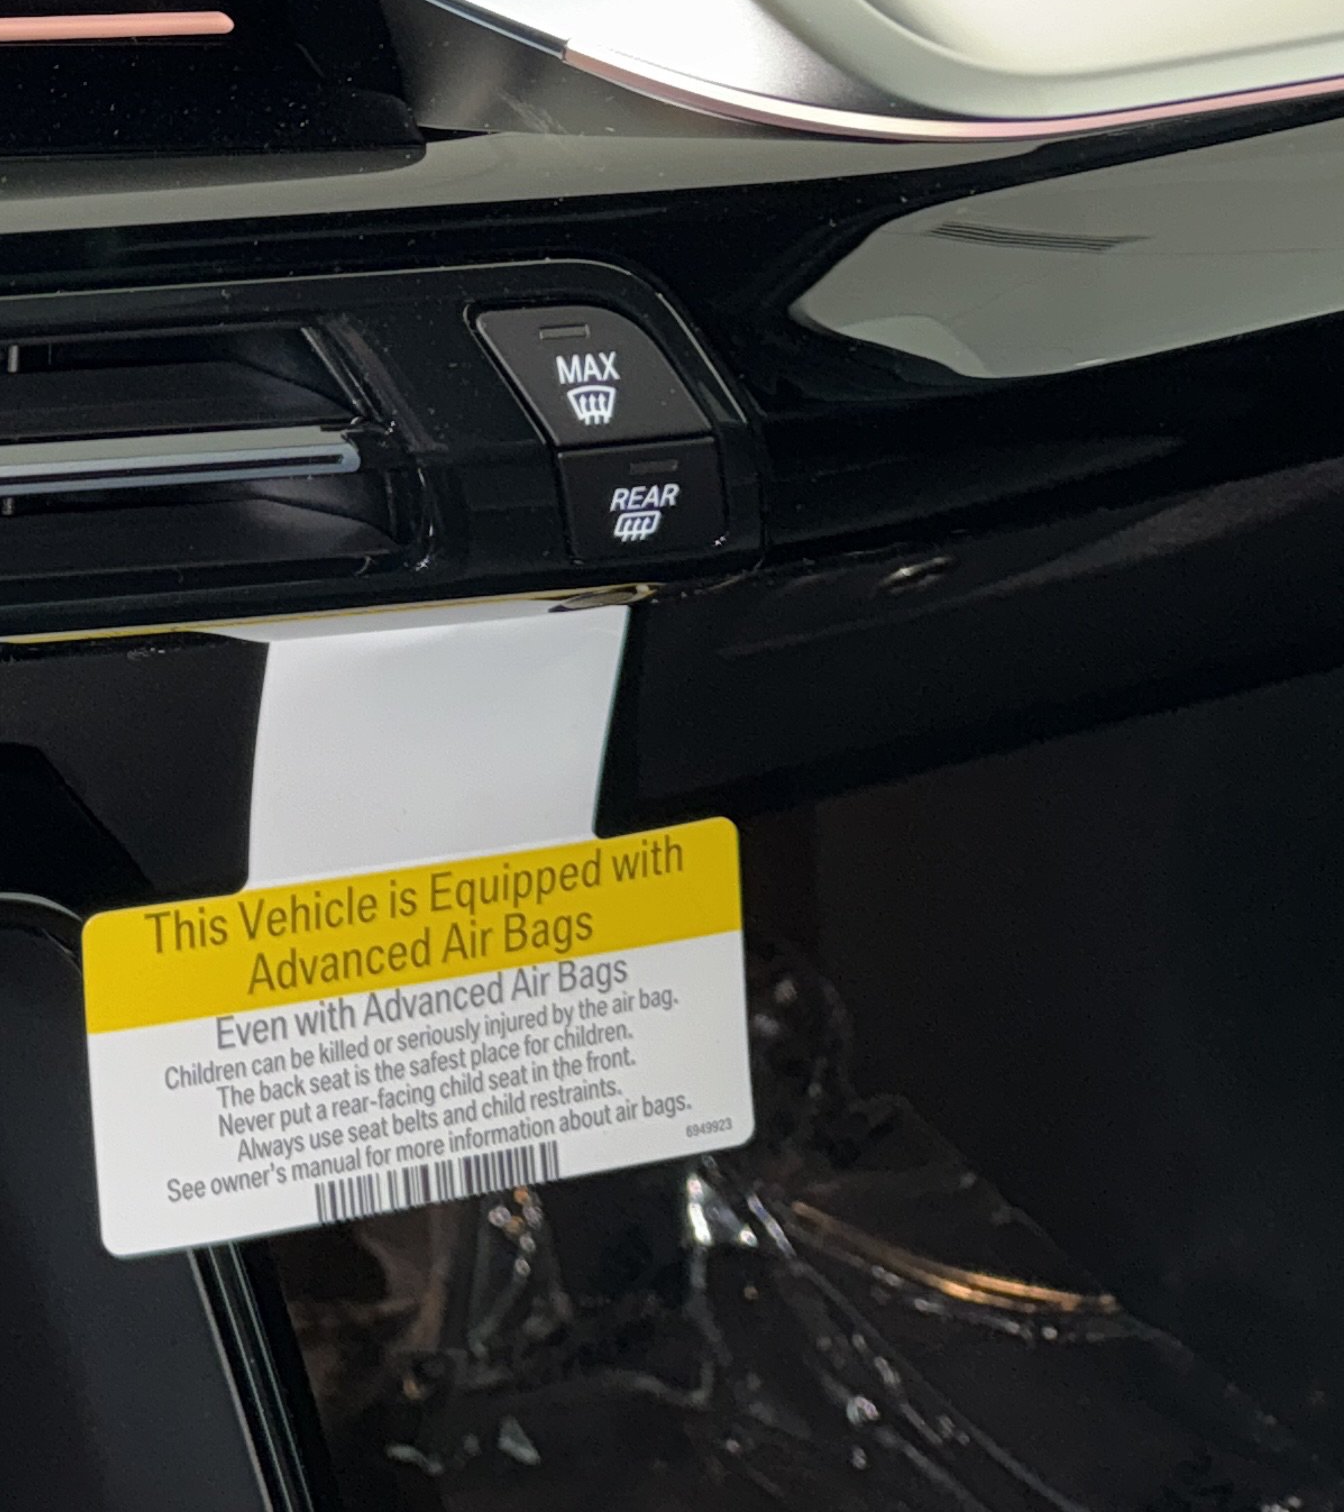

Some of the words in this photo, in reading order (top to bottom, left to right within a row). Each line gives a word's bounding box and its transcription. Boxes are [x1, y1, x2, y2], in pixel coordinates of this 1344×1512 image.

[556, 351, 620, 385] MAX
[610, 483, 680, 512] REAR
[144, 905, 228, 954] This
[237, 886, 378, 940] Vehicle
[389, 879, 418, 919] is
[430, 847, 602, 916] Equipped
[611, 834, 684, 882] with
[247, 926, 432, 995] Advanced
[441, 920, 494, 963] Air
[504, 910, 594, 954] Bags
[165, 1061, 247, 1090] Children
[252, 1054, 286, 1076] can
[290, 1047, 315, 1070] be
[318, 1035, 369, 1065] killed
[373, 1036, 394, 1056] or
[396, 1018, 480, 1052] seriously
[484, 1005, 548, 1039] injured
[552, 1003, 574, 1028] by
[578, 997, 608, 1020] the
[612, 993, 635, 1015] air
[639, 988, 679, 1011] bag.
[216, 1013, 289, 1050] Even
[294, 997, 356, 1038] with
[363, 971, 504, 1026] Advanced
[511, 967, 551, 1001] Air
[558, 959, 628, 992] Bags
[216, 1085, 255, 1109] The
[261, 1075, 307, 1102] back
[309, 1068, 352, 1094] seat
[355, 1063, 371, 1087] is
[374, 1059, 405, 1083] the
[409, 1050, 466, 1078] safest
[470, 1041, 520, 1070] place
[524, 1034, 550, 1057] for
[554, 1022, 634, 1051] children.
[218, 1112, 275, 1137] Never
[280, 1102, 312, 1132] put
[316, 1104, 328, 1121] a
[331, 1084, 435, 1118] rear-facing
[440, 1070, 484, 1100] child
[488, 1068, 529, 1090] seat
[532, 1062, 549, 1083] in
[552, 1056, 582, 1080] the
[586, 1046, 636, 1072] front.
[166, 1178, 206, 1203] See
[210, 1162, 288, 1196] owner's
[291, 1148, 361, 1181] manual
[365, 1144, 392, 1167] for
[396, 1137, 445, 1163] more
[449, 1118, 555, 1154] information
[559, 1107, 613, 1133] about
[616, 1099, 638, 1122] air
[642, 1093, 693, 1118] bags.
[237, 1135, 305, 1162] Always
[309, 1128, 345, 1150] use
[347, 1116, 389, 1142] seat
[392, 1108, 438, 1135] belts
[443, 1098, 478, 1126] and
[481, 1091, 526, 1119] child
[530, 1077, 623, 1111] restraints.
